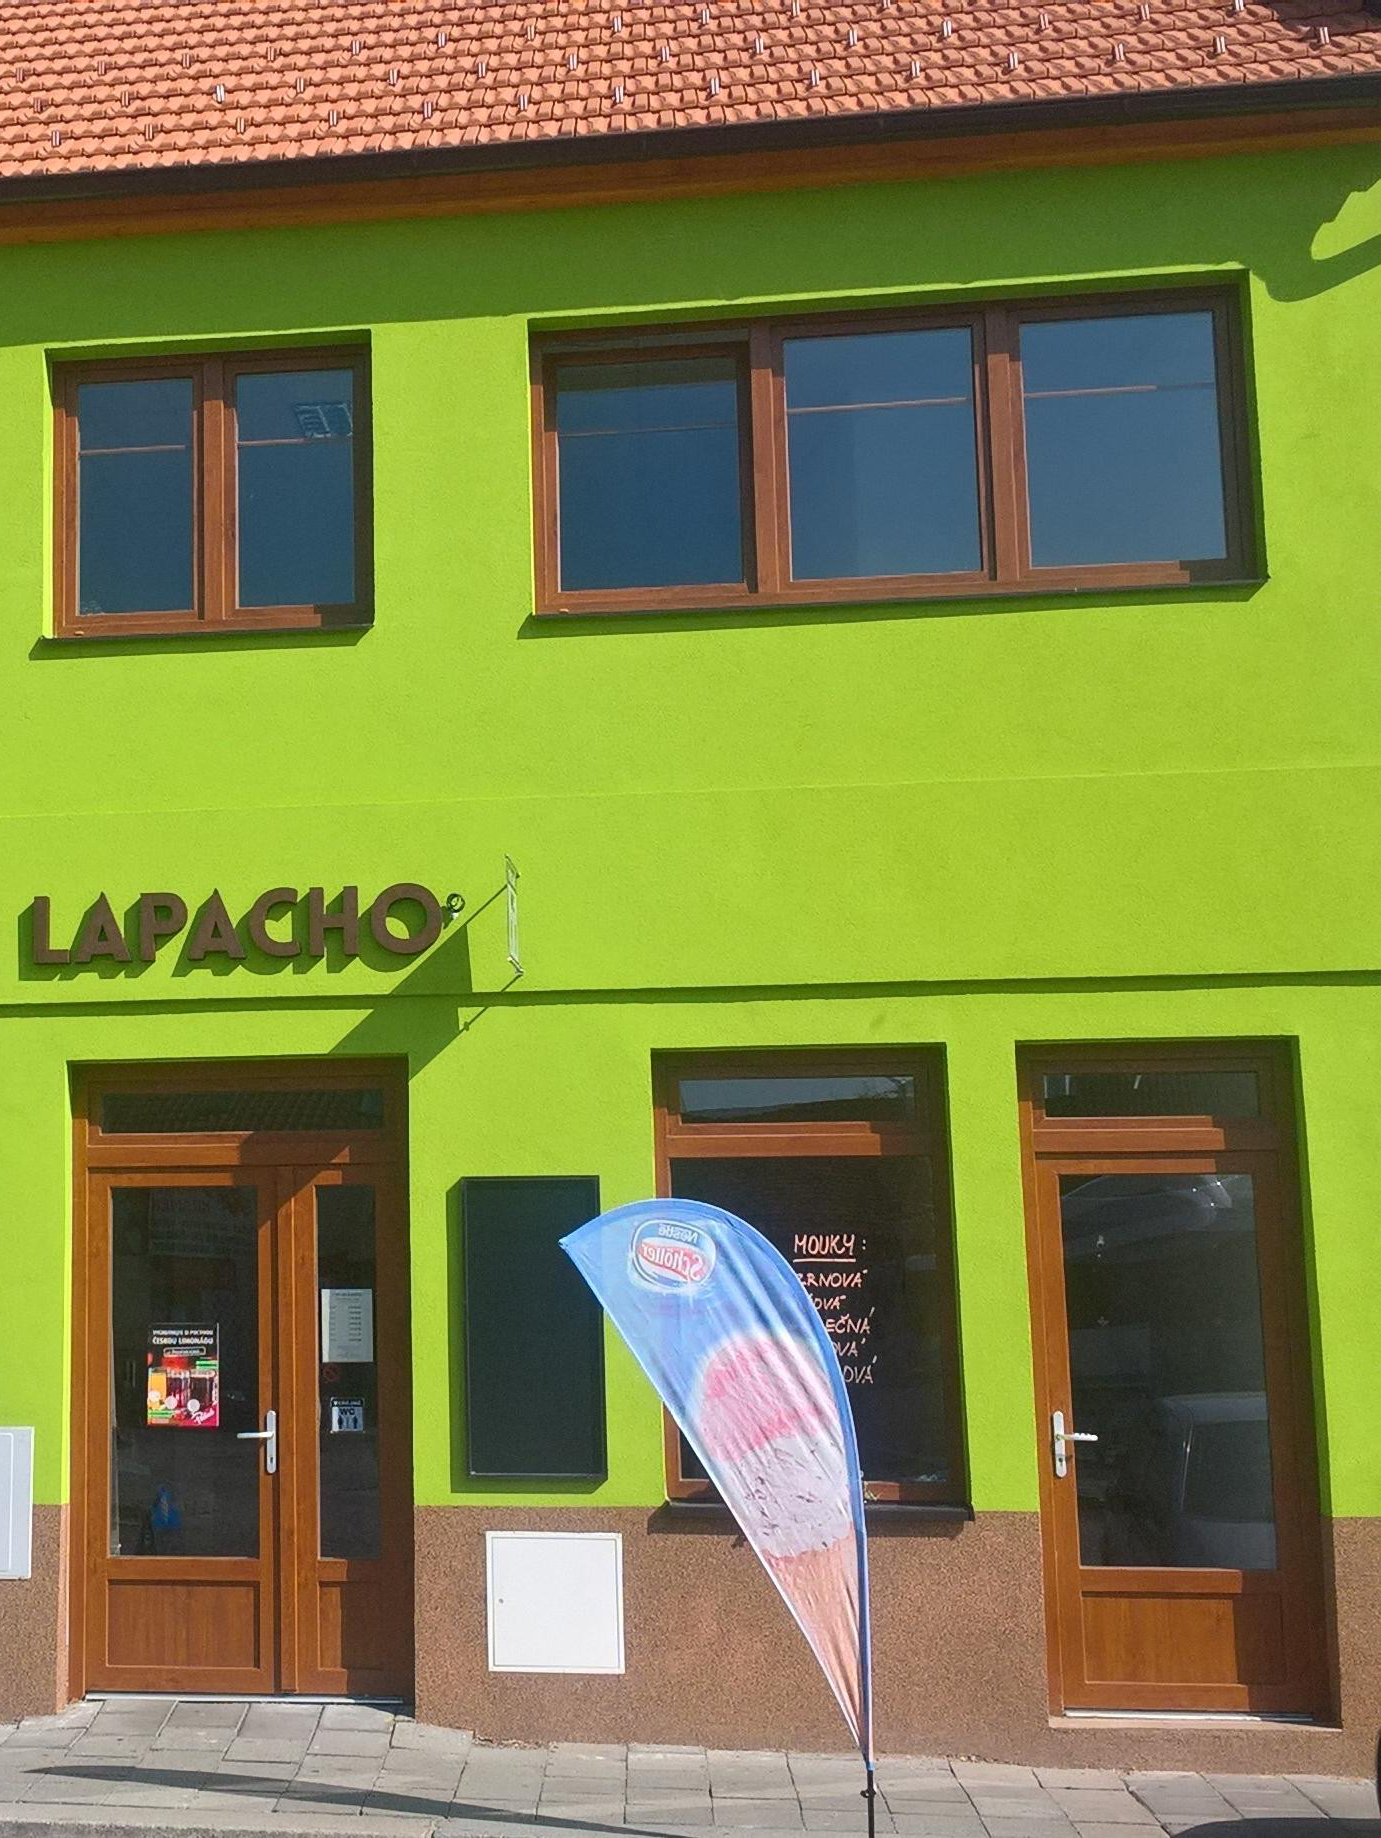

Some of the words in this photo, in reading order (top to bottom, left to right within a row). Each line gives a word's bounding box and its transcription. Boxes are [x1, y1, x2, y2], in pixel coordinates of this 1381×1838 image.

[31, 882, 444, 966] LAPACHO
[825, 1307, 875, 1334] EČNÁ
[842, 1355, 878, 1384] OVÁ
[339, 1407, 356, 1416] WC
